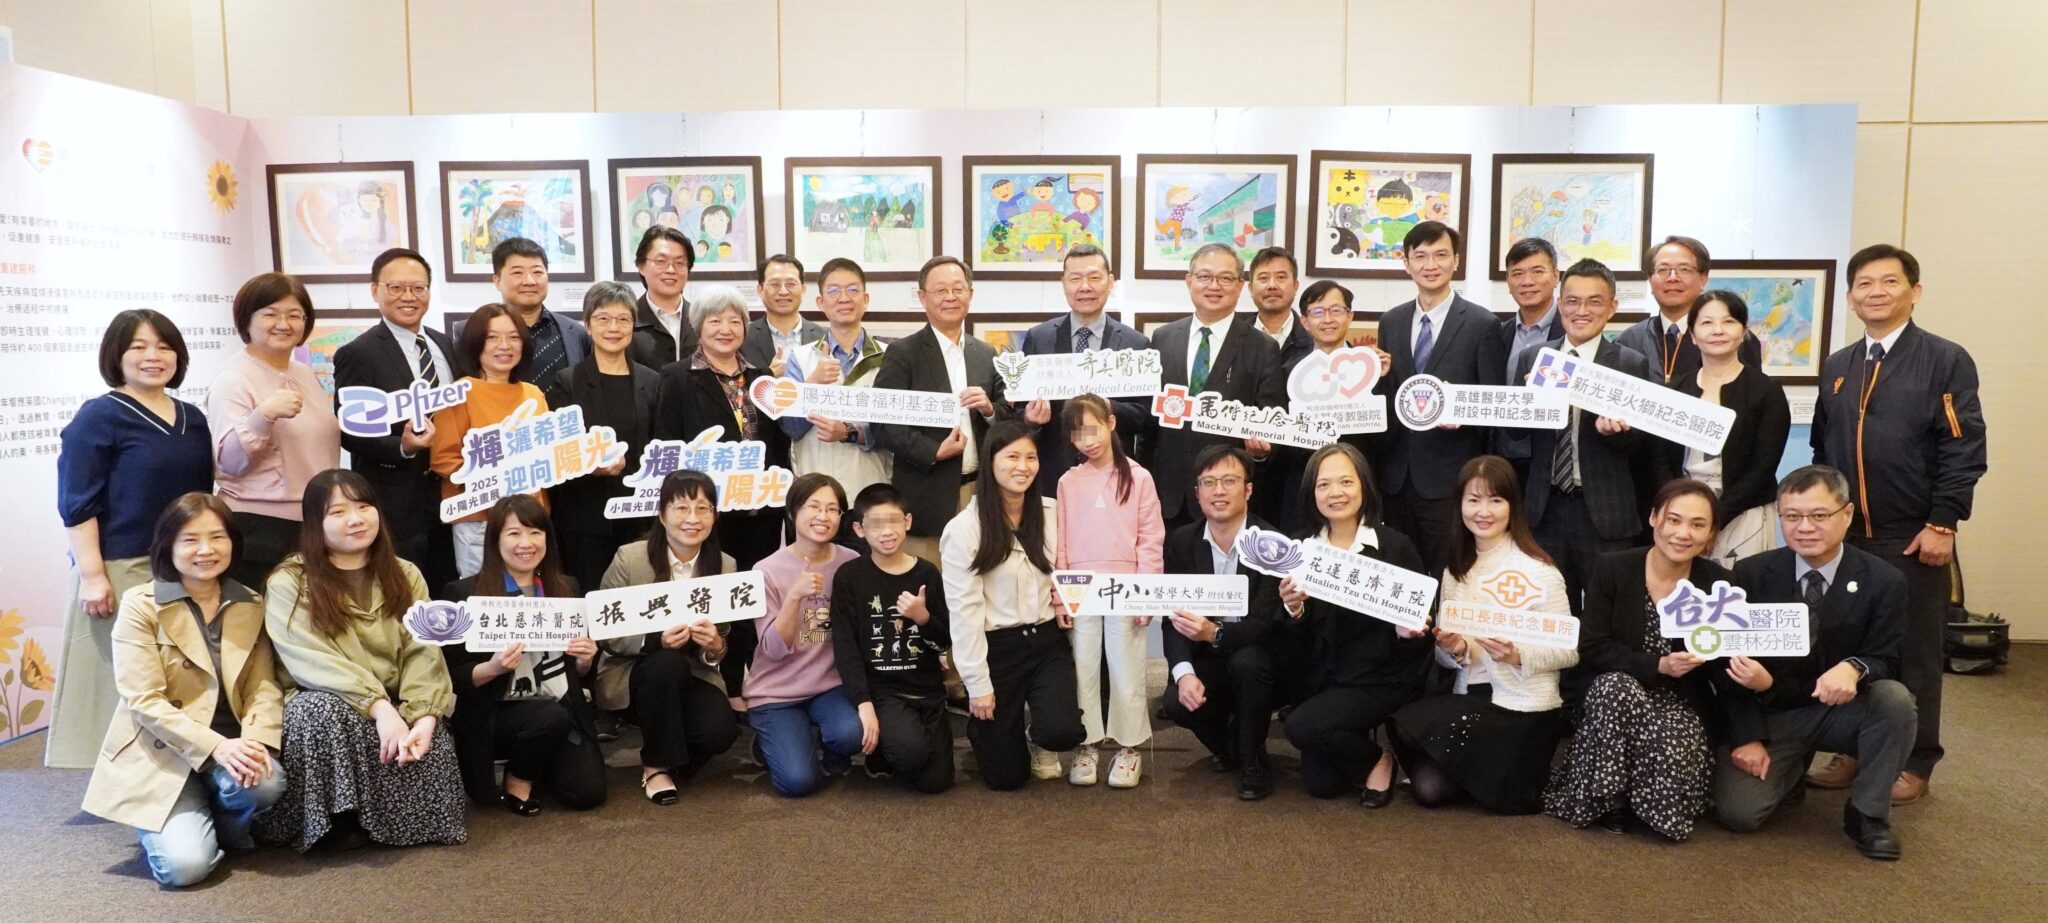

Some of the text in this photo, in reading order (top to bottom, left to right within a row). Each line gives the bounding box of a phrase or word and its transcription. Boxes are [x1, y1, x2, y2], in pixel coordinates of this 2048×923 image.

[1037, 382, 1158, 396] Chi Mei Medical Center
[1455, 390, 1534, 406] 高雄醫學大學
[396, 382, 470, 429] Pfizer
[802, 387, 956, 414] 陽光社會福利基金會
[1572, 376, 1724, 440] 新光吳火獅紀念醫院
[802, 406, 954, 425] Sunshine Social Welfare Foundation
[1453, 406, 1561, 422] 附設中和紀念醫院
[1197, 420, 1233, 434] Mackay
[1241, 427, 1286, 441] Memorial
[504, 430, 616, 496] 迎向陽光
[471, 476, 498, 493] 2025
[640, 488, 662, 498] 202
[716, 471, 788, 507] 陽光
[1305, 574, 1340, 592] Hualien
[1343, 586, 1360, 598] Tzu
[1363, 592, 1379, 604] Chi
[1308, 557, 1426, 608] 花蓮慈濟醫院
[596, 582, 758, 626] 振興醫院
[479, 611, 584, 629] 台北慈濟醫院
[1444, 605, 1574, 636] 林口長庚紀念醫院
[478, 631, 580, 641] Taipei Tzu Chi Hospital
[1723, 633, 1802, 651] 雲林分院
